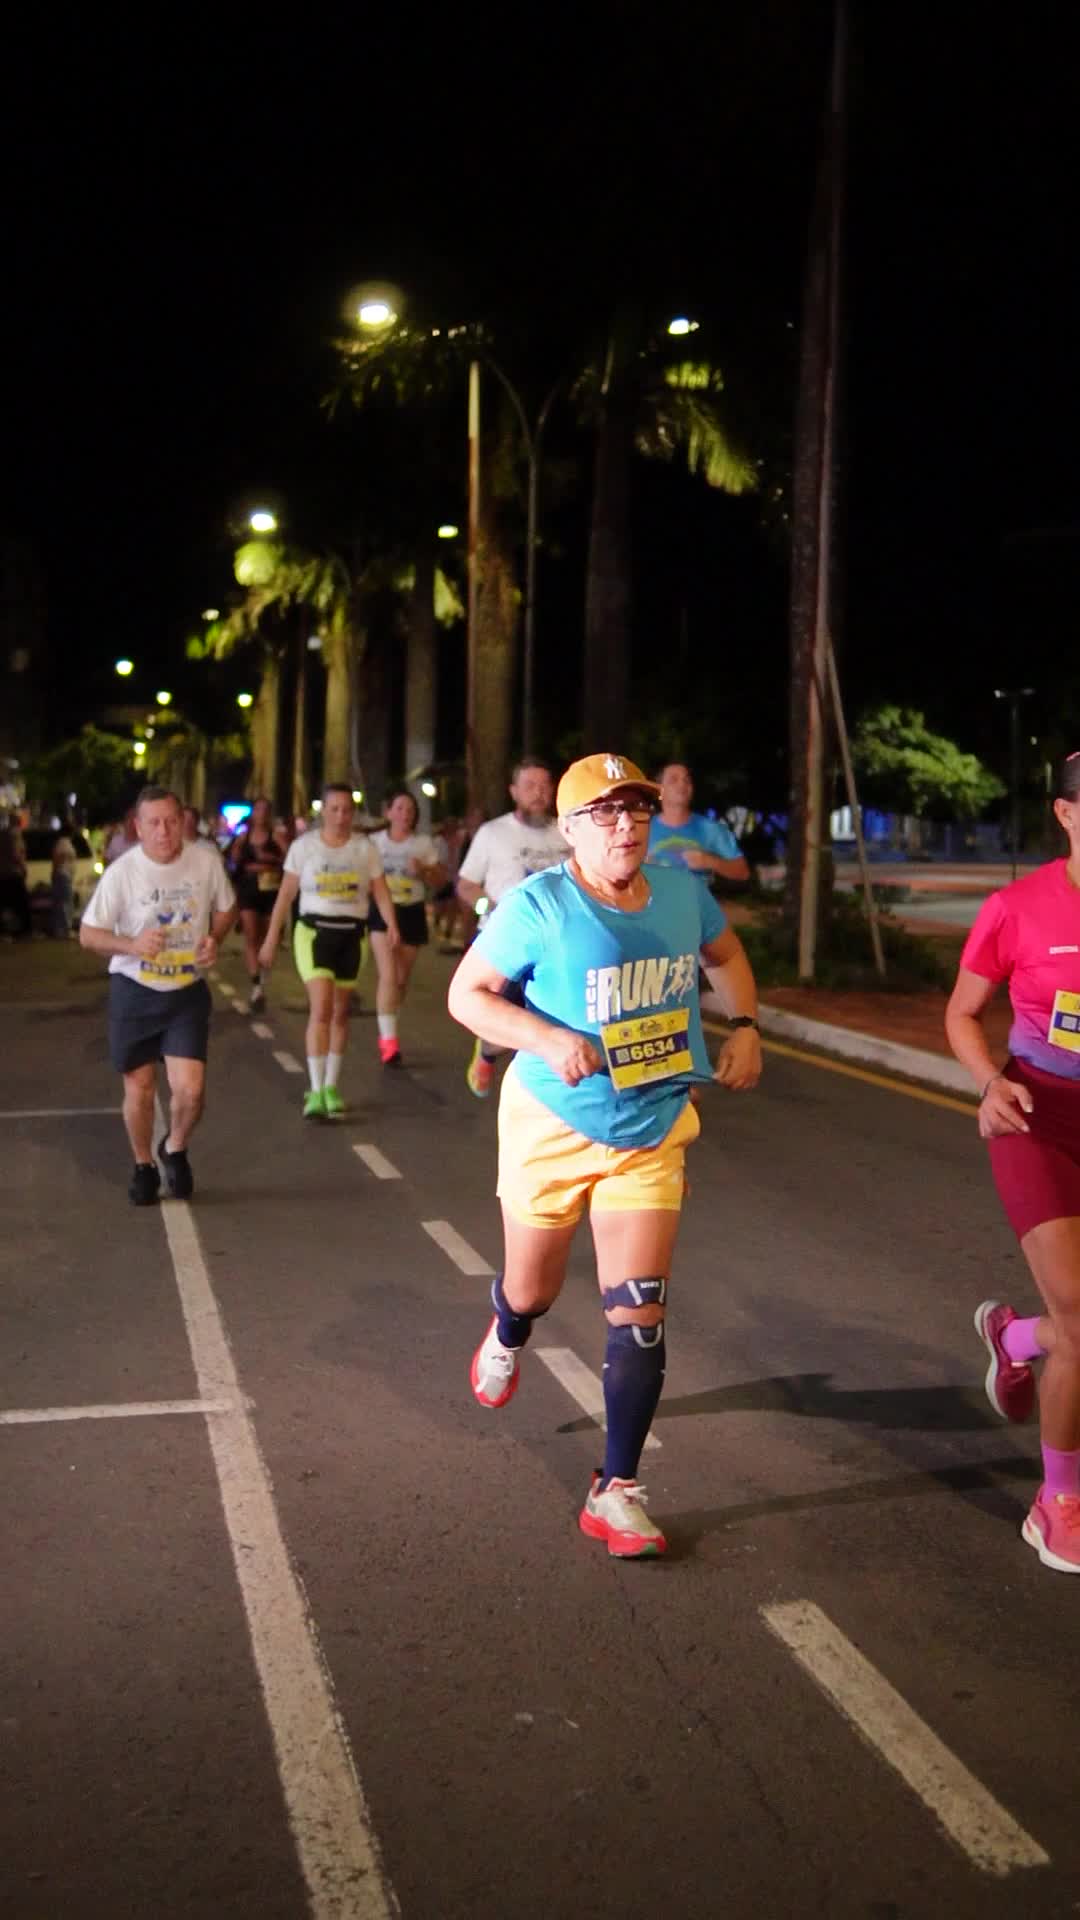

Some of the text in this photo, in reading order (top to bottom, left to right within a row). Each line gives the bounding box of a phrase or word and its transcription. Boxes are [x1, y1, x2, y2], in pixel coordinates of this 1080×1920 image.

[603, 756, 627, 779] NY
[597, 957, 669, 1023] RUN
[631, 1038, 675, 1061] 6634
